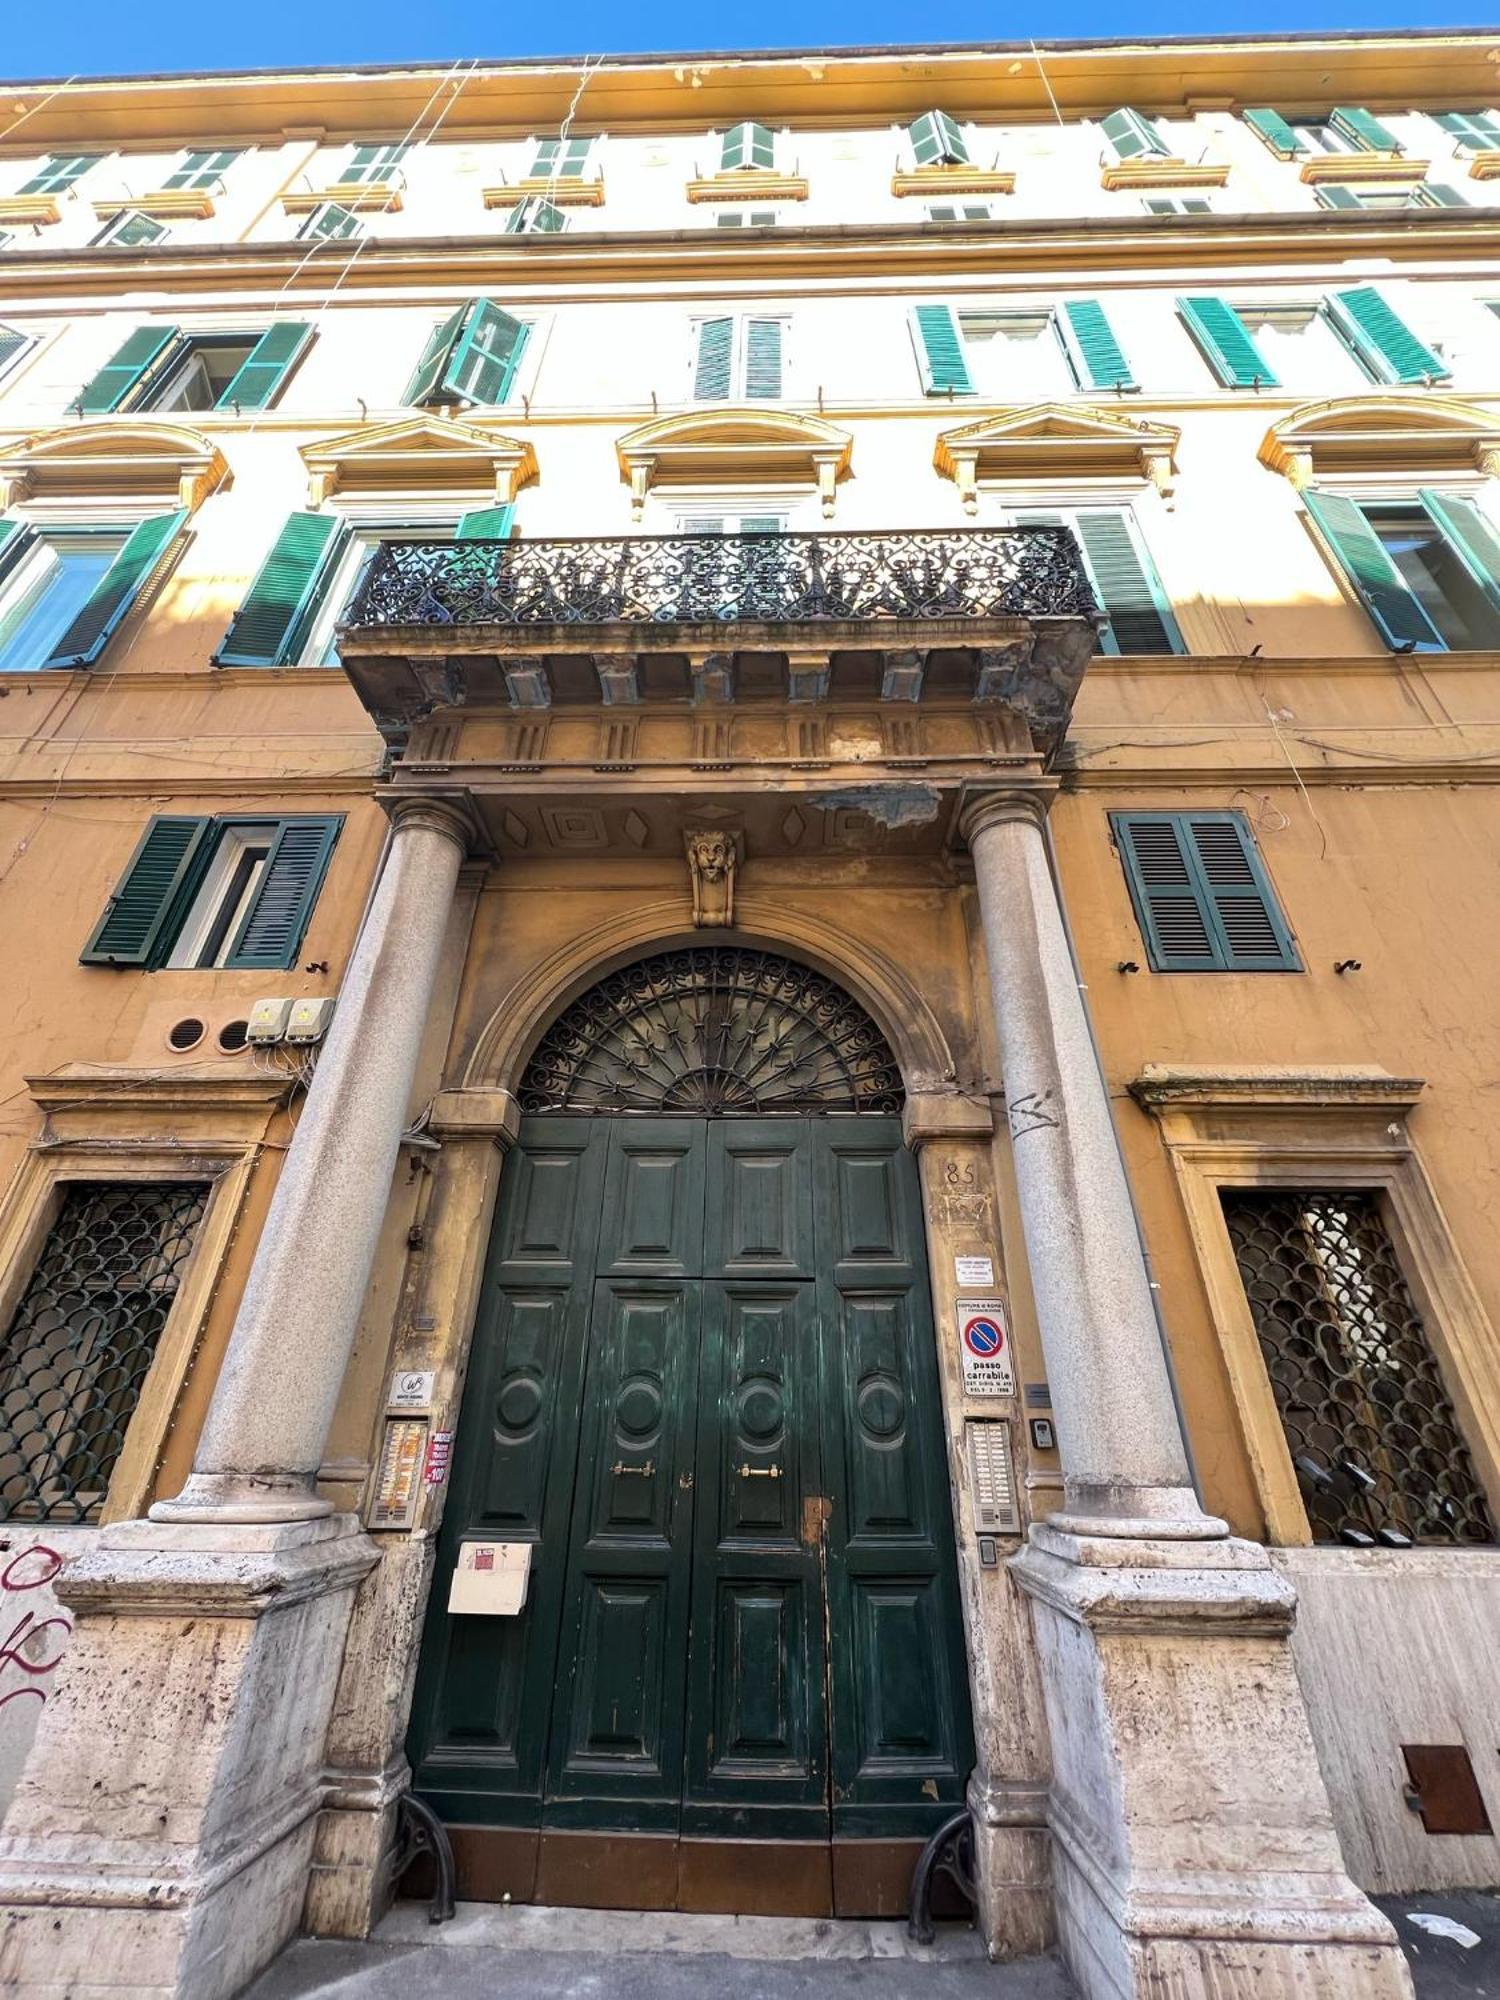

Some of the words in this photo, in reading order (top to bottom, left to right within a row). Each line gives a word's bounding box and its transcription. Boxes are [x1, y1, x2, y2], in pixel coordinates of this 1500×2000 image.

[947, 1163, 974, 1184] 85
[973, 1362, 1001, 1370] passo
[966, 1371, 1010, 1380] carrabile
